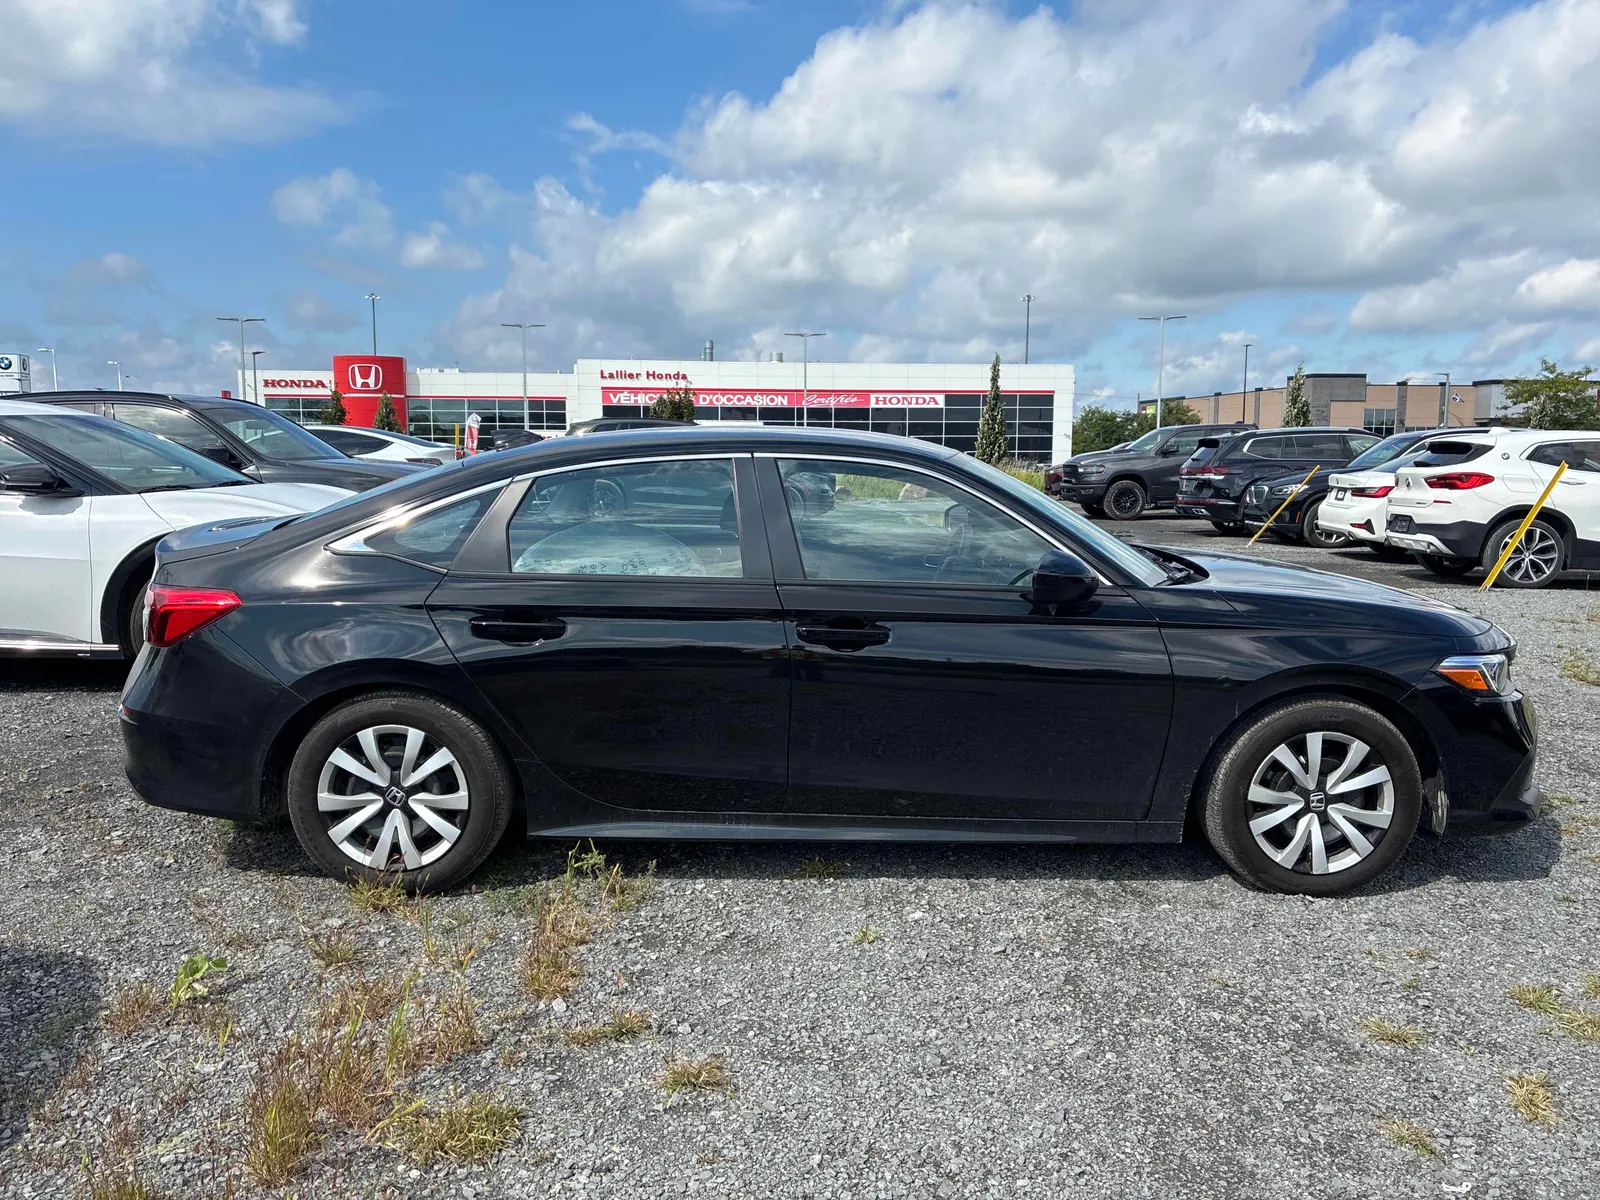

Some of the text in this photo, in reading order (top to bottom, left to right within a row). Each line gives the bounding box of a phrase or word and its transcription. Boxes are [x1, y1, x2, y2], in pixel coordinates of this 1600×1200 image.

[600, 370, 688, 380] Lallier Honda
[263, 379, 327, 388] HONDA
[609, 392, 695, 404] VÉHIC
[699, 394, 788, 406] D'OCCASION
[874, 396, 940, 406] HONDA
